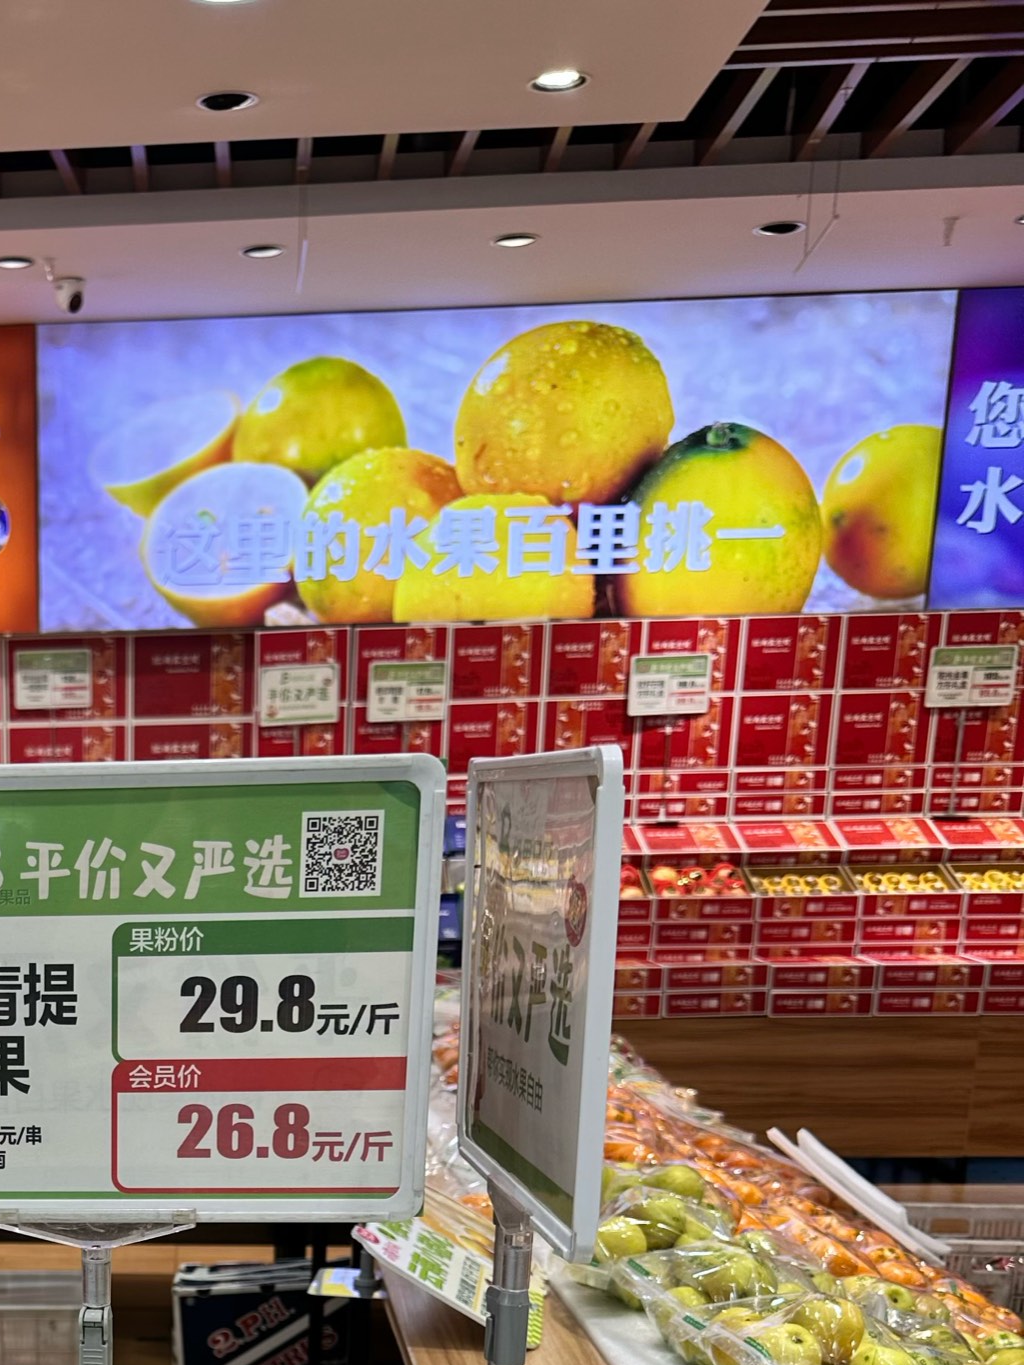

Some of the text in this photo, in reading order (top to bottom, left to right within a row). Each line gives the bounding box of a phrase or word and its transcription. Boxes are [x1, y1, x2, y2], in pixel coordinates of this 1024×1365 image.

[158, 500, 785, 586] 这里的水果百里挑一
[20, 834, 294, 901] 平价又严选
[129, 927, 204, 953] 果粉价
[180, 974, 400, 1036] 29.8元/斤
[484, 940, 574, 1067] 价又严选
[128, 1065, 202, 1089] 会员价
[177, 1103, 394, 1163] 26.8元/斤
